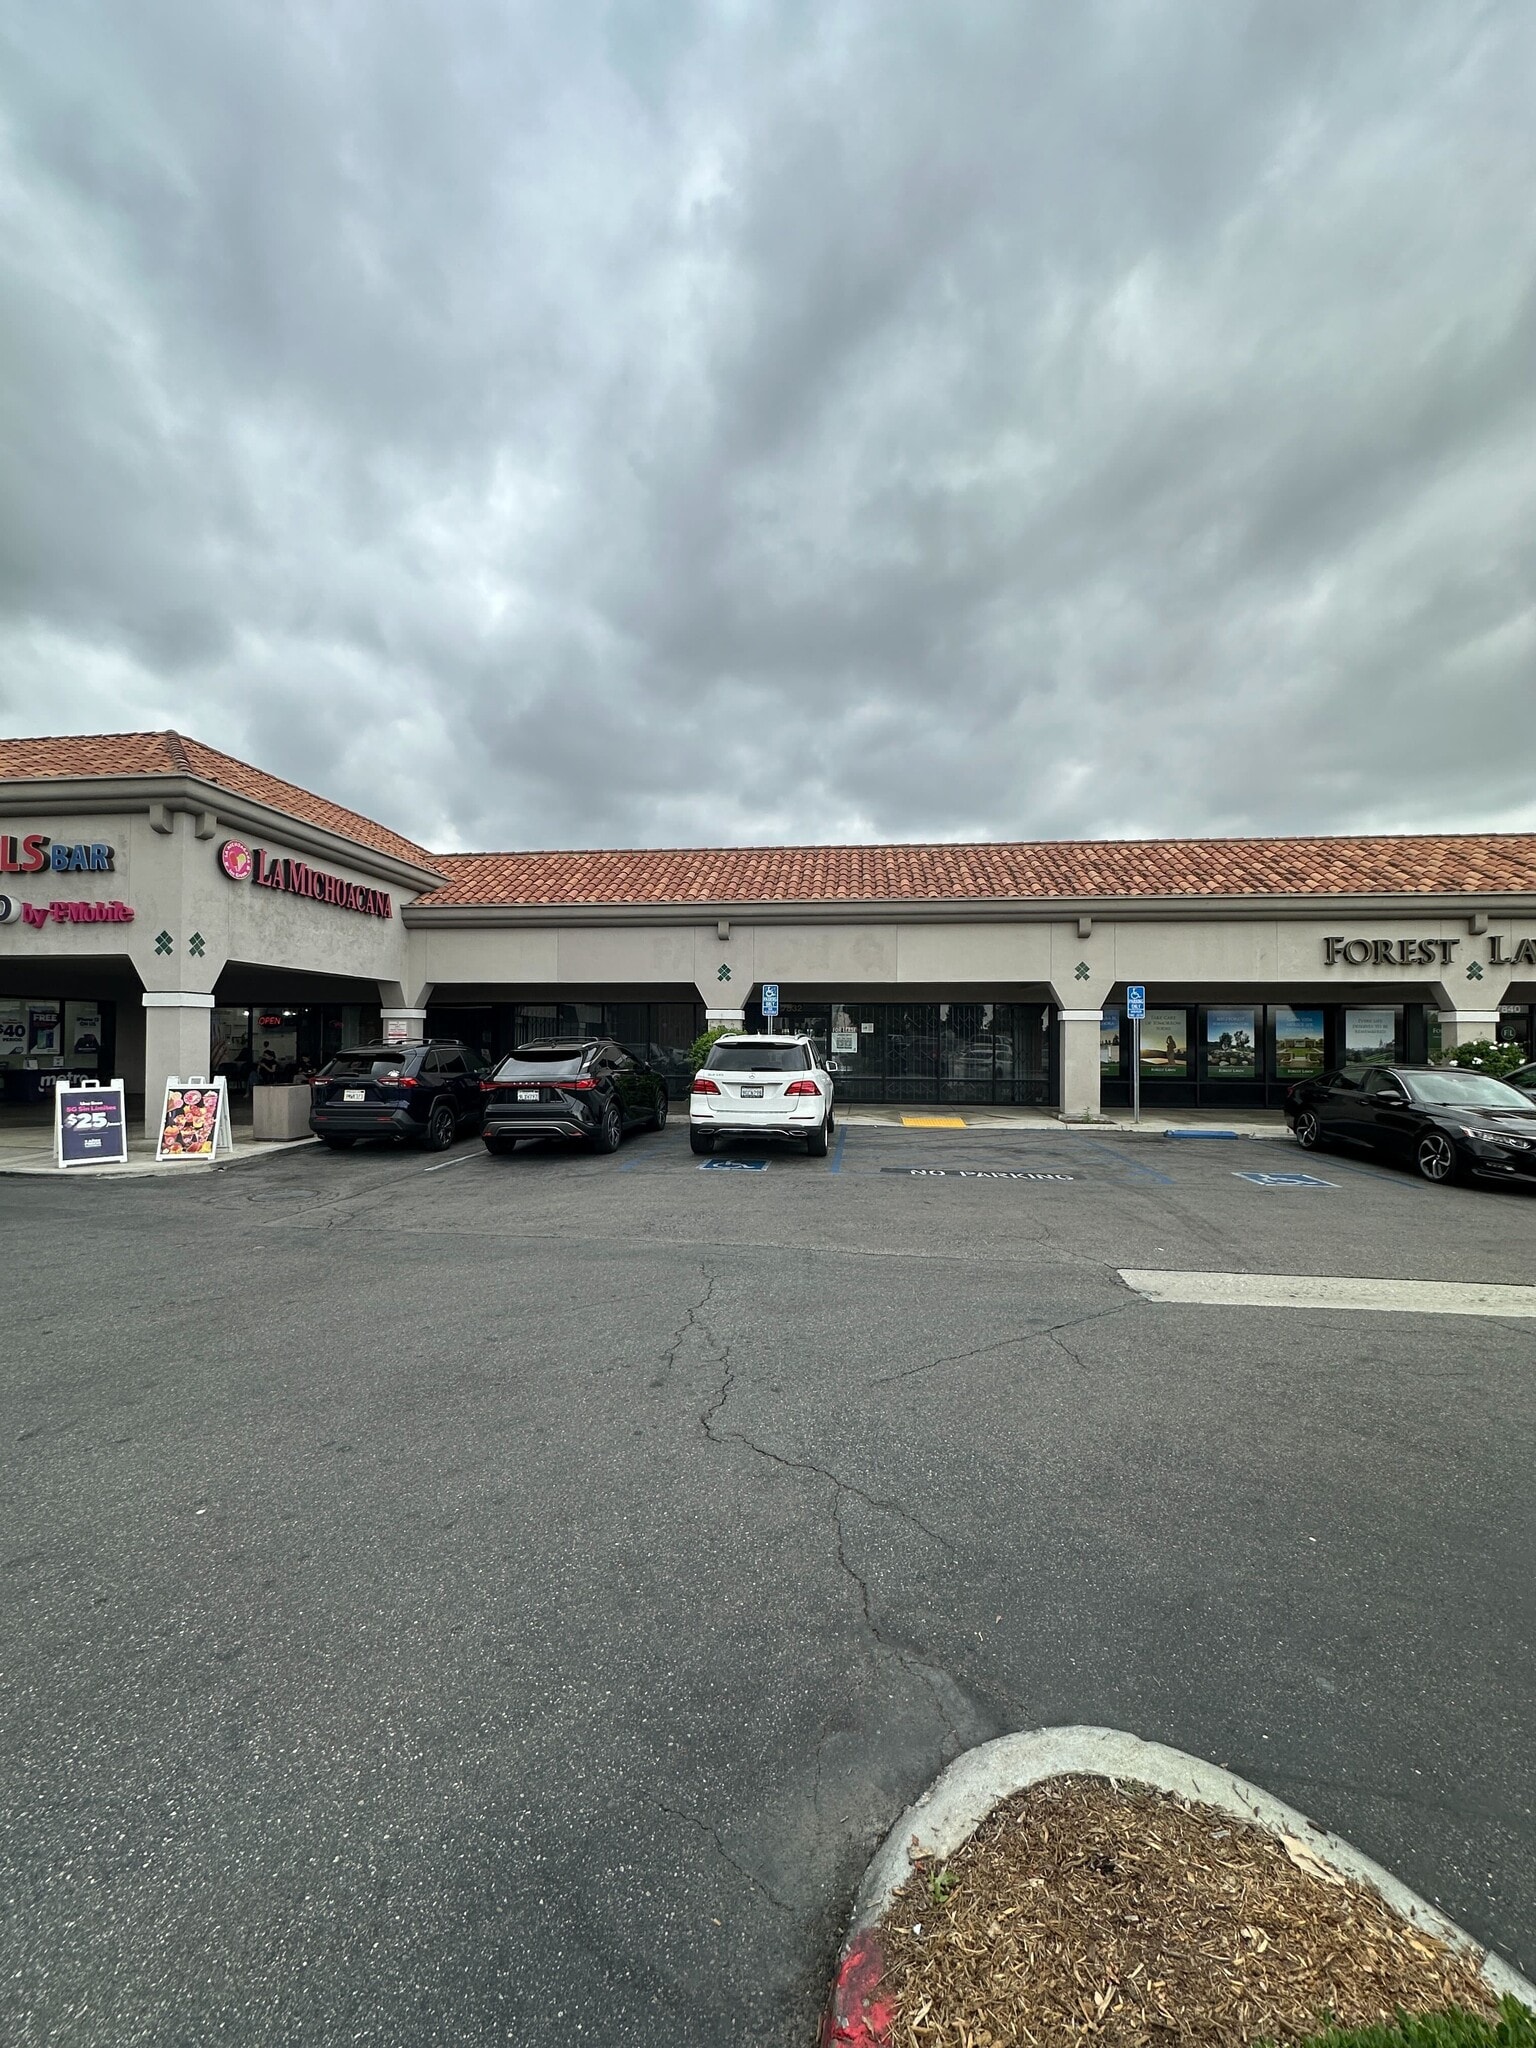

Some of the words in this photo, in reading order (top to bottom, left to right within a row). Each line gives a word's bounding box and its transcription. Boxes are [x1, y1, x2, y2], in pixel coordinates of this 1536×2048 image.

[51, 842, 115, 872] BAR
[252, 848, 286, 891] LA
[284, 858, 393, 919] MICHOACANA
[22, 902, 50, 929] by
[49, 901, 135, 923] T-Mobile
[1323, 936, 1460, 965] FOREST
[33, 1013, 58, 1022] FREE
[258, 1015, 282, 1026] OPEN
[910, 1168, 946, 1177] NO
[959, 1170, 1074, 1181] PARKING
